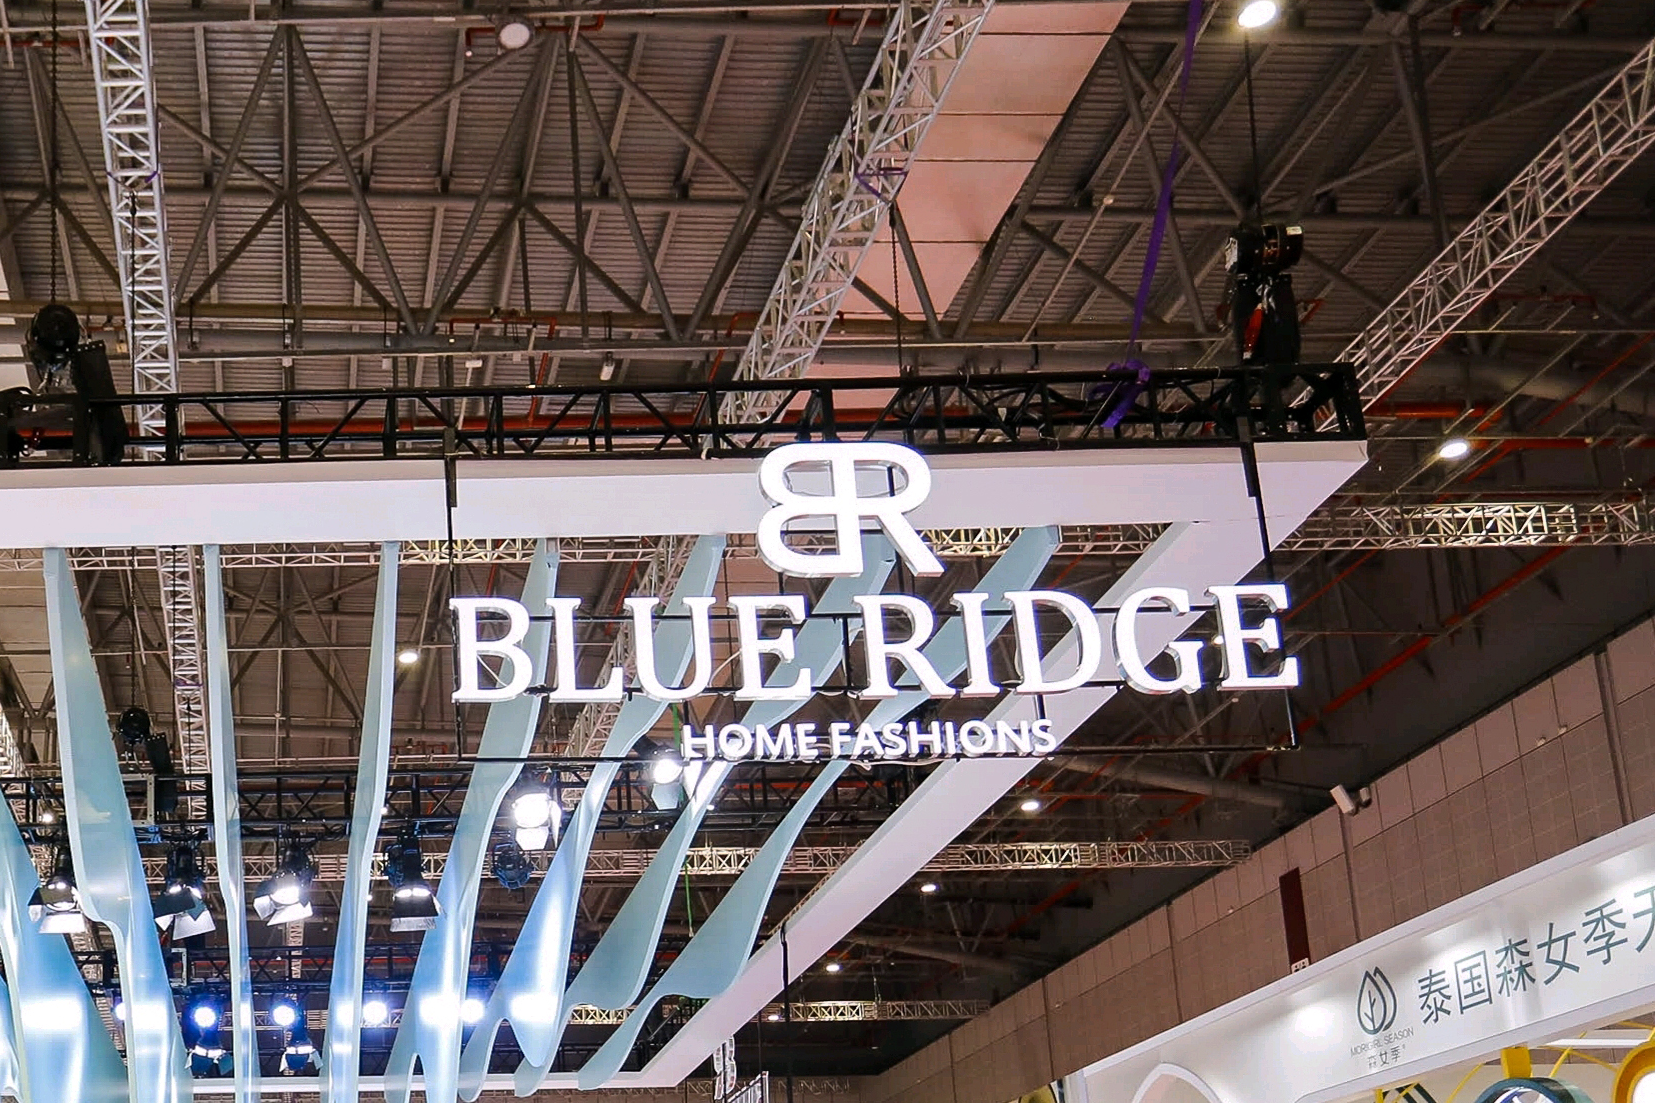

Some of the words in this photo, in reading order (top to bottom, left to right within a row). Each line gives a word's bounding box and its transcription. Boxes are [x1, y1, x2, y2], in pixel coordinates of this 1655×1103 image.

[449, 594, 813, 703] BLUE
[851, 583, 1300, 698] RIDGE
[682, 723, 817, 761] HOME
[829, 719, 1058, 760] FASHIONS
